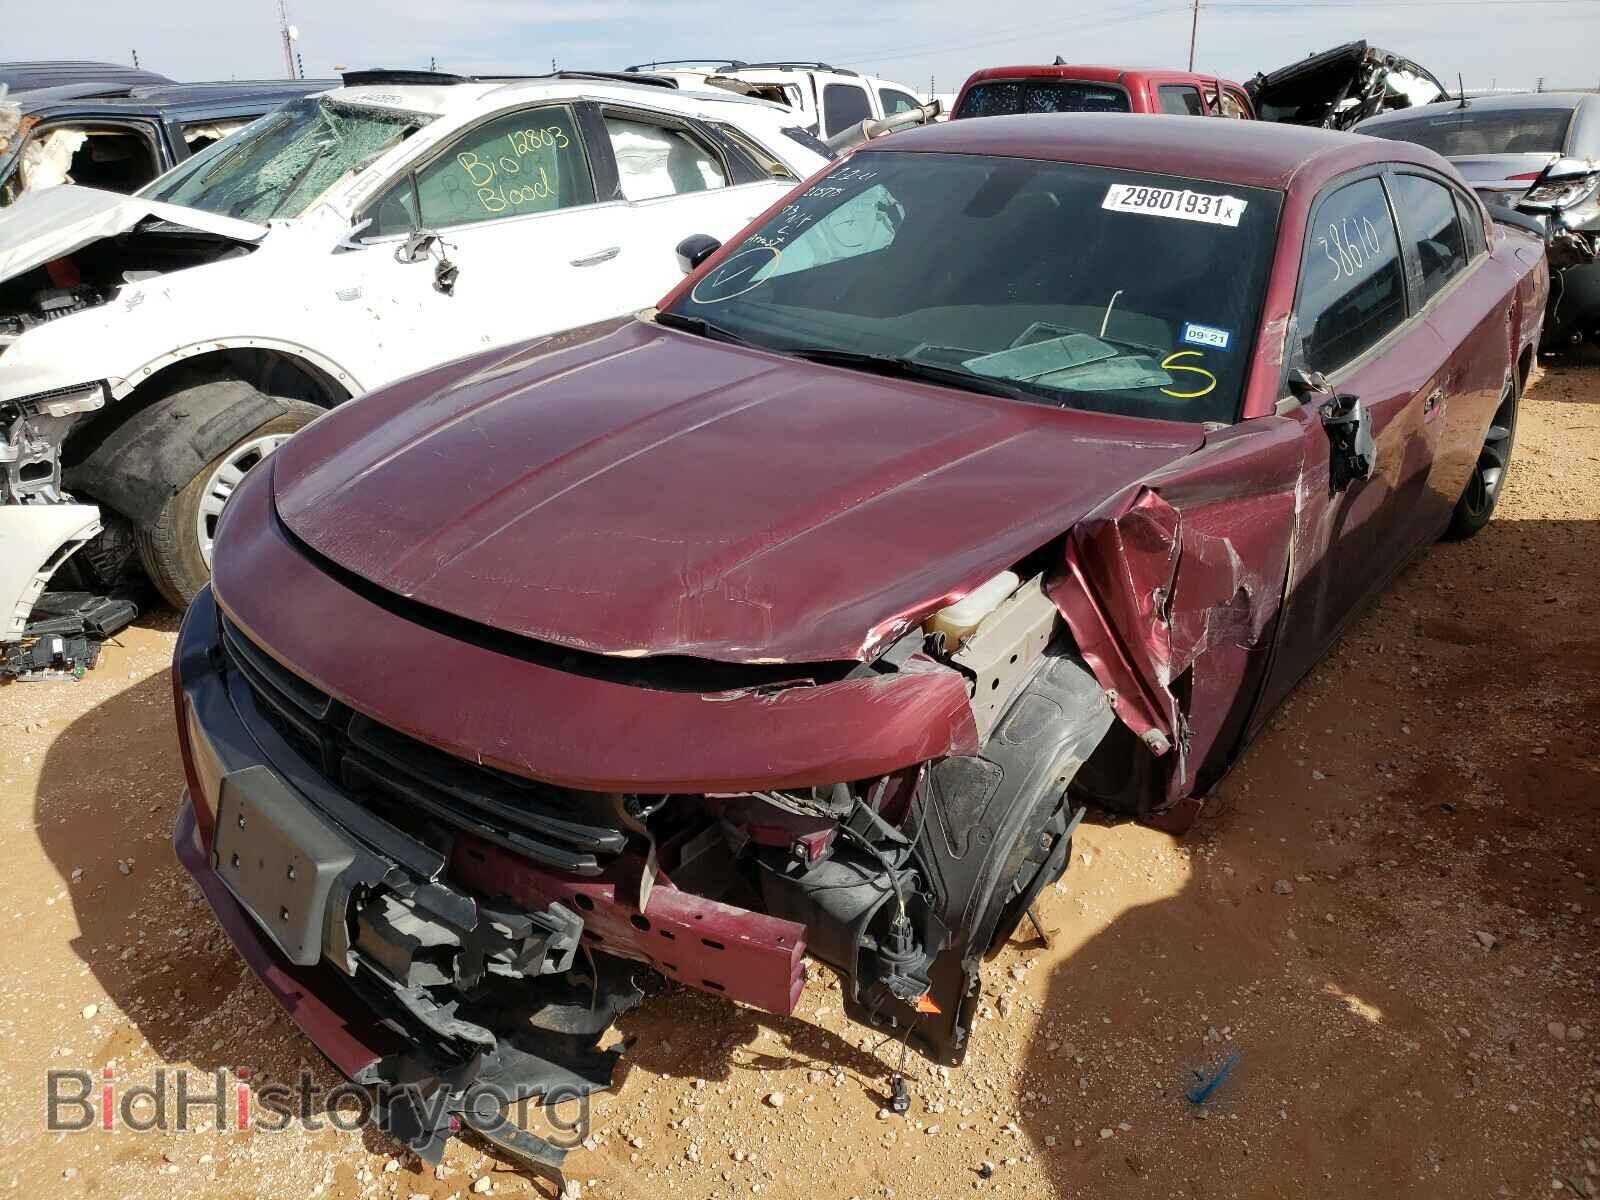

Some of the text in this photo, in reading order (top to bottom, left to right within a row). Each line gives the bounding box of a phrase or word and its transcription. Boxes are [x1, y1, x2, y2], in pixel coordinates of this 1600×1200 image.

[507, 126, 569, 158] 12803
[456, 152, 520, 187] Bio
[477, 167, 556, 212] Blood
[1121, 187, 1224, 217] 29801931
[1316, 216, 1379, 281] 38610
